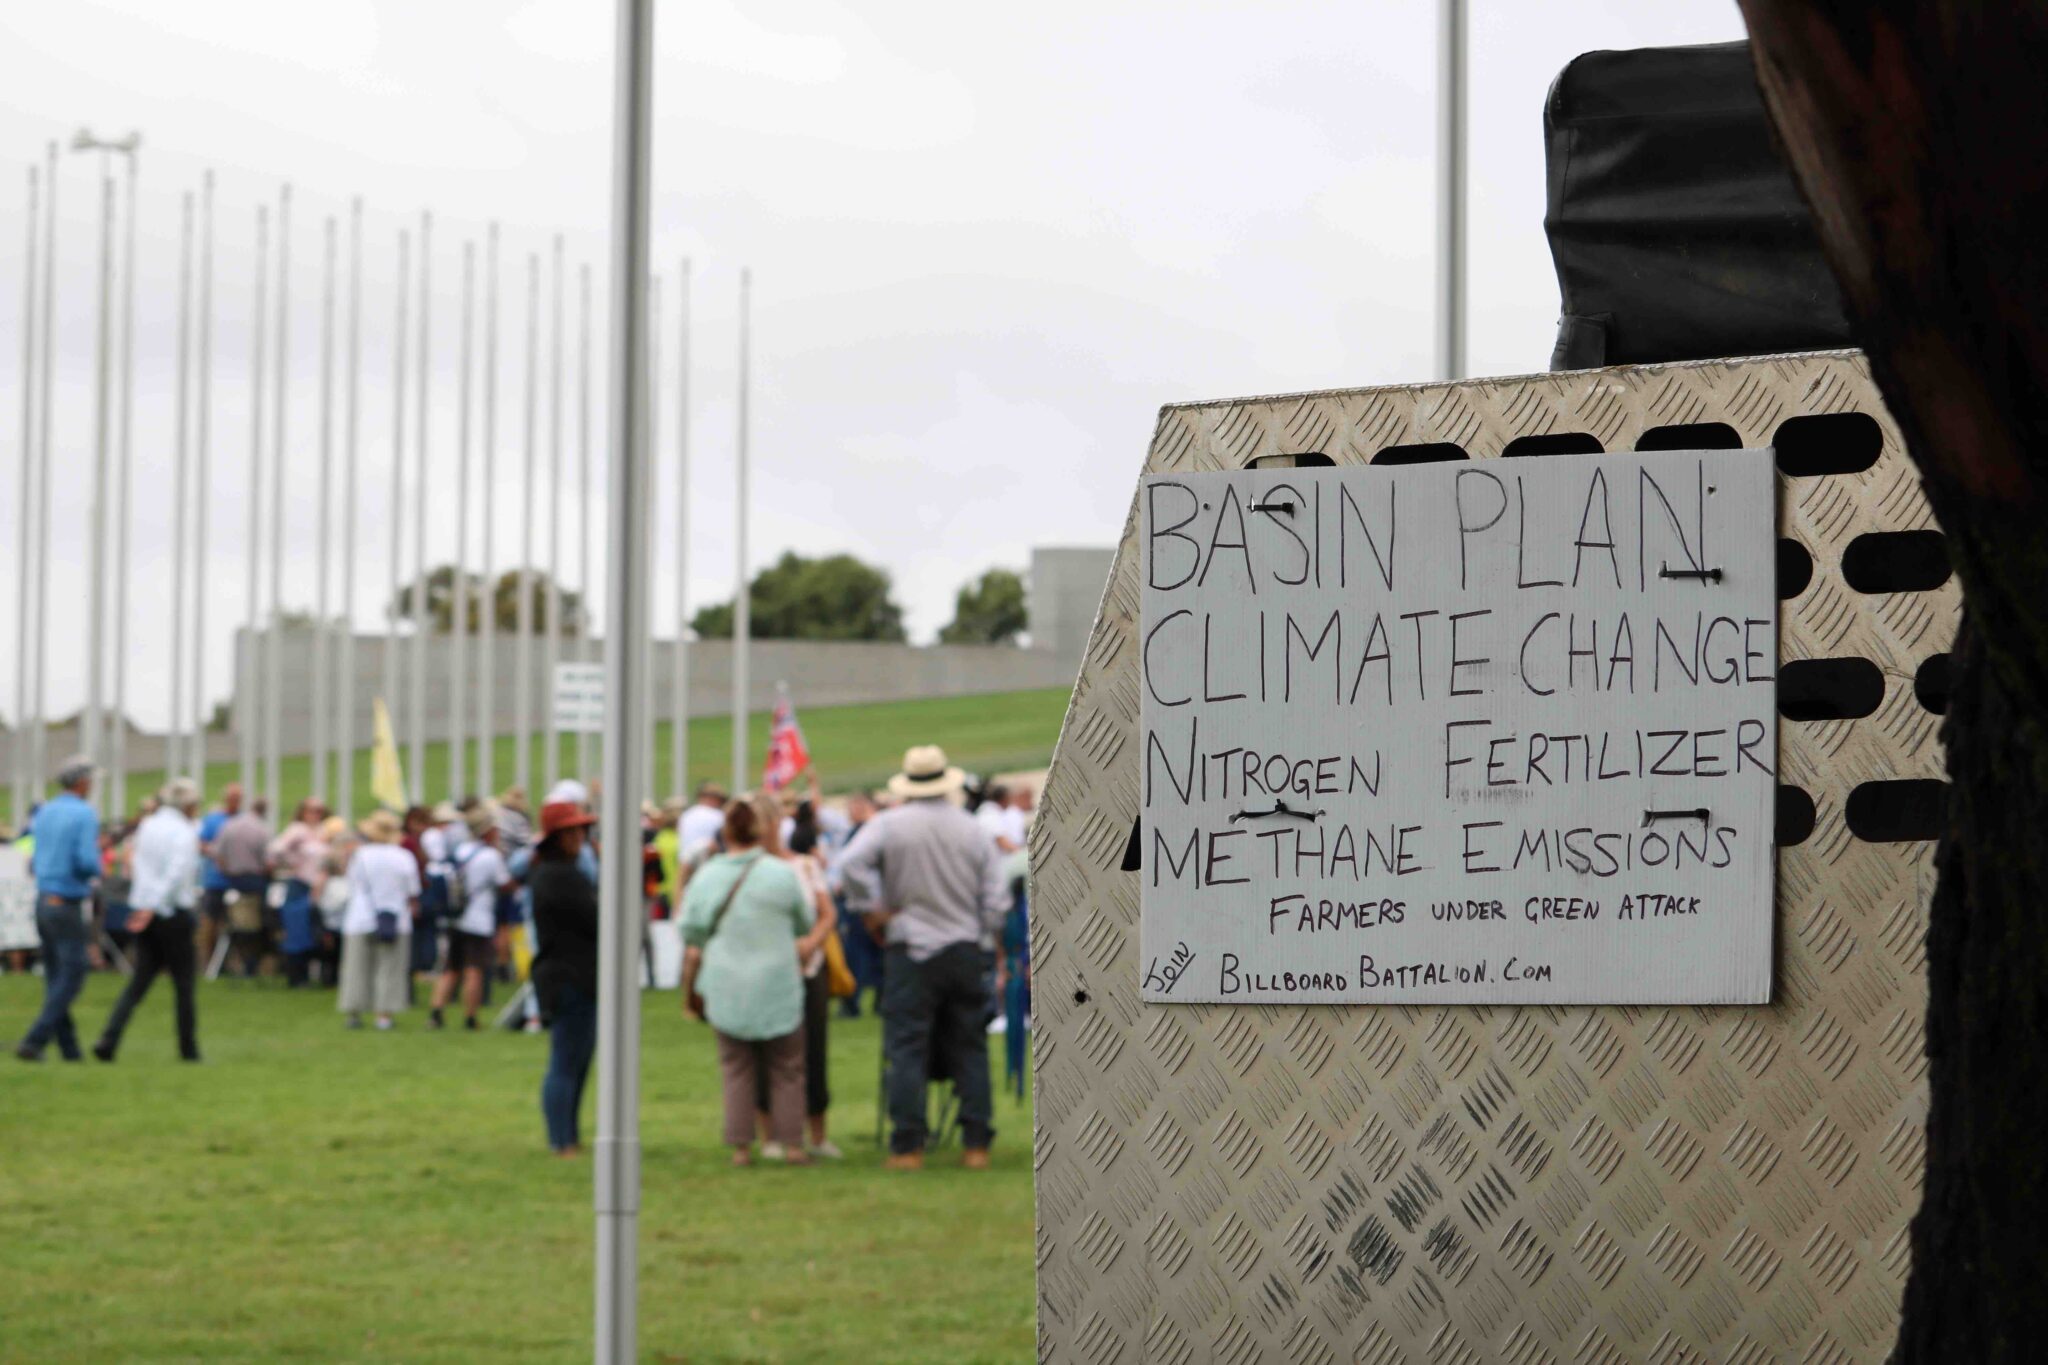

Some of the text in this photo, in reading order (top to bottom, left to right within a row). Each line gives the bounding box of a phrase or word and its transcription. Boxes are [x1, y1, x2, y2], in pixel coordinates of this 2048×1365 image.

[1147, 459, 1706, 594] BASIN PLAN
[1143, 609, 1775, 707] CLIMATE CHANGE
[1146, 716, 1775, 808] NITROGEN FERTILIZER
[1153, 821, 1737, 890] METHANE EMISSIONS
[1270, 894, 1701, 935] FARMERS UNDER GREEN ATTACK
